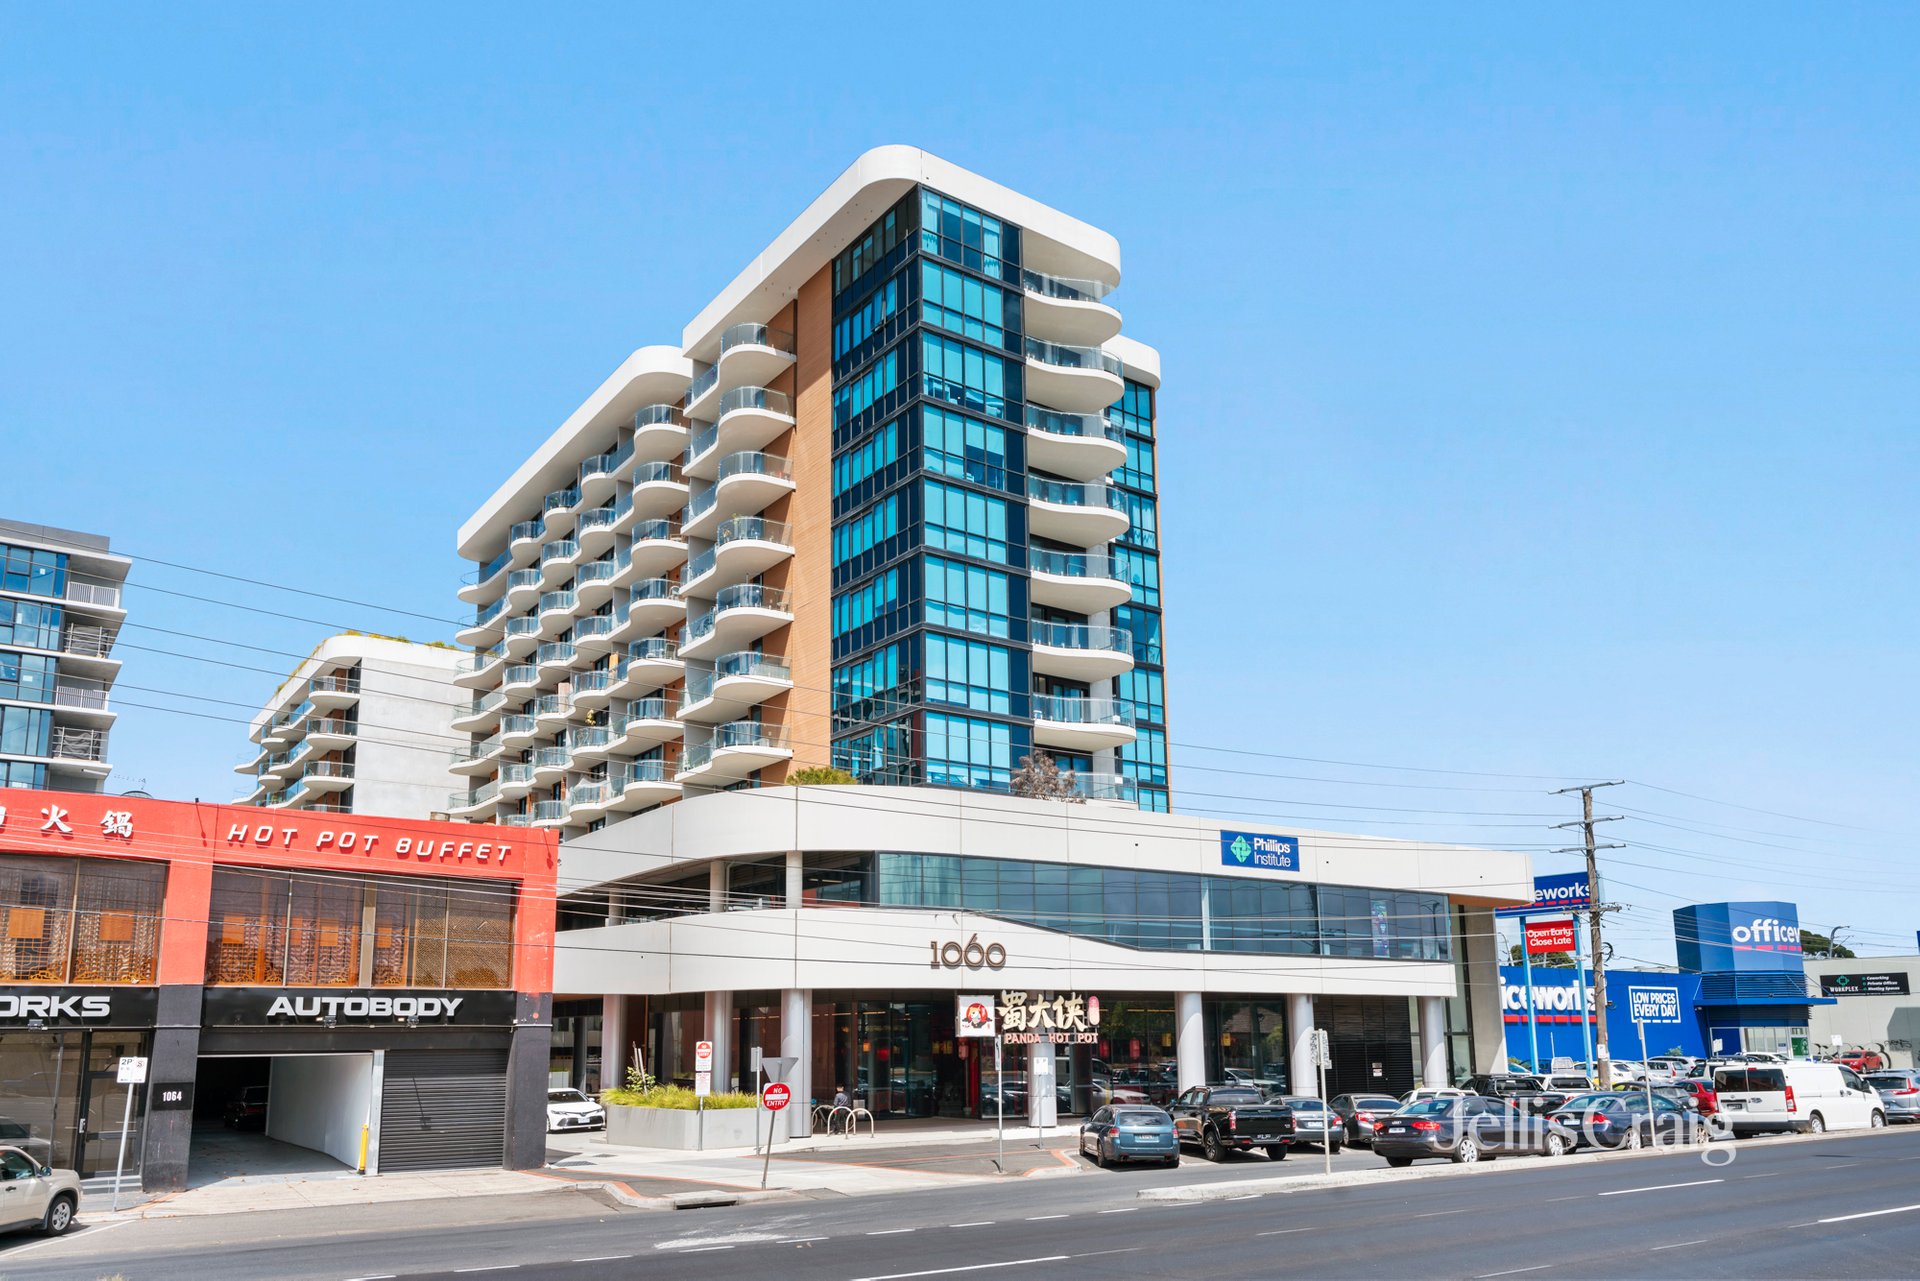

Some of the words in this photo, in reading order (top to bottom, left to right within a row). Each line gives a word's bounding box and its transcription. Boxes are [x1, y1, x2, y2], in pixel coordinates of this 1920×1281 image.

[0, 804, 134, 838] 火鍋
[227, 824, 298, 845] HOT
[316, 831, 378, 851] POT
[396, 838, 511, 861] BUFFET
[1254, 837, 1291, 854] Phillips
[1254, 852, 1291, 868] Institute
[1527, 930, 1550, 939] Open
[1530, 938, 1553, 947] Close
[1553, 936, 1572, 945] Late
[931, 933, 1006, 968] 1060
[1633, 992, 1649, 1003] LOW
[1650, 993, 1676, 1004] PRICES
[0, 995, 111, 1018] ORKS
[266, 996, 463, 1017] AUTOBODY
[1634, 1004, 1659, 1016] EVERY
[1660, 1004, 1677, 1016] DAY
[1004, 1032, 1042, 1043] PANDA
[1048, 1032, 1071, 1043] HOT
[1077, 1032, 1099, 1043] POT
[163, 1091, 182, 1102] 1064
